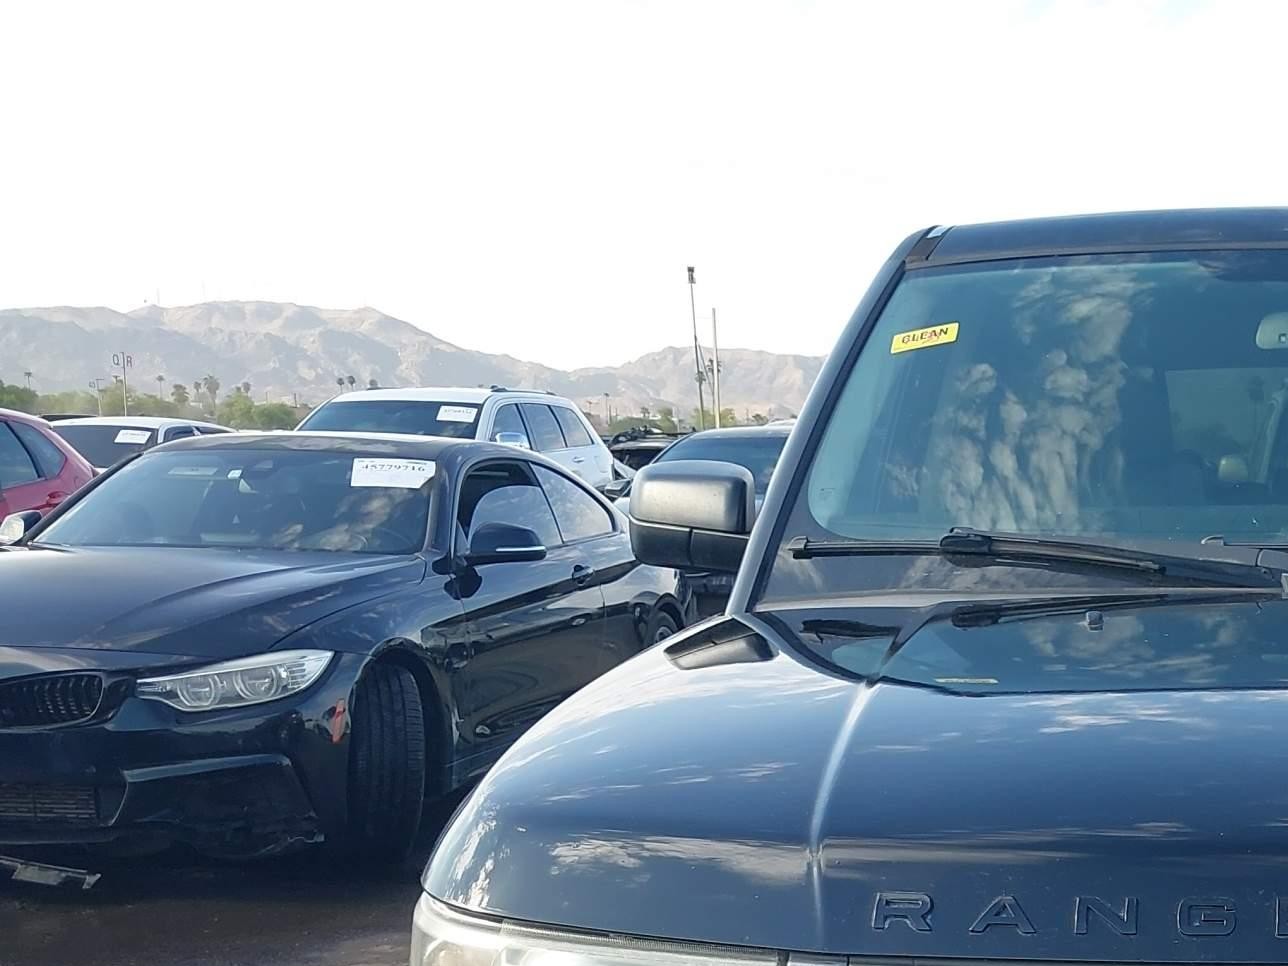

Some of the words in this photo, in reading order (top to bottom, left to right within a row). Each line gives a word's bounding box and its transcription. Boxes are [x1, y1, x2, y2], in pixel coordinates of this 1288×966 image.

[902, 327, 949, 344] CLEAN
[112, 353, 121, 366] Q
[126, 355, 133, 368] R
